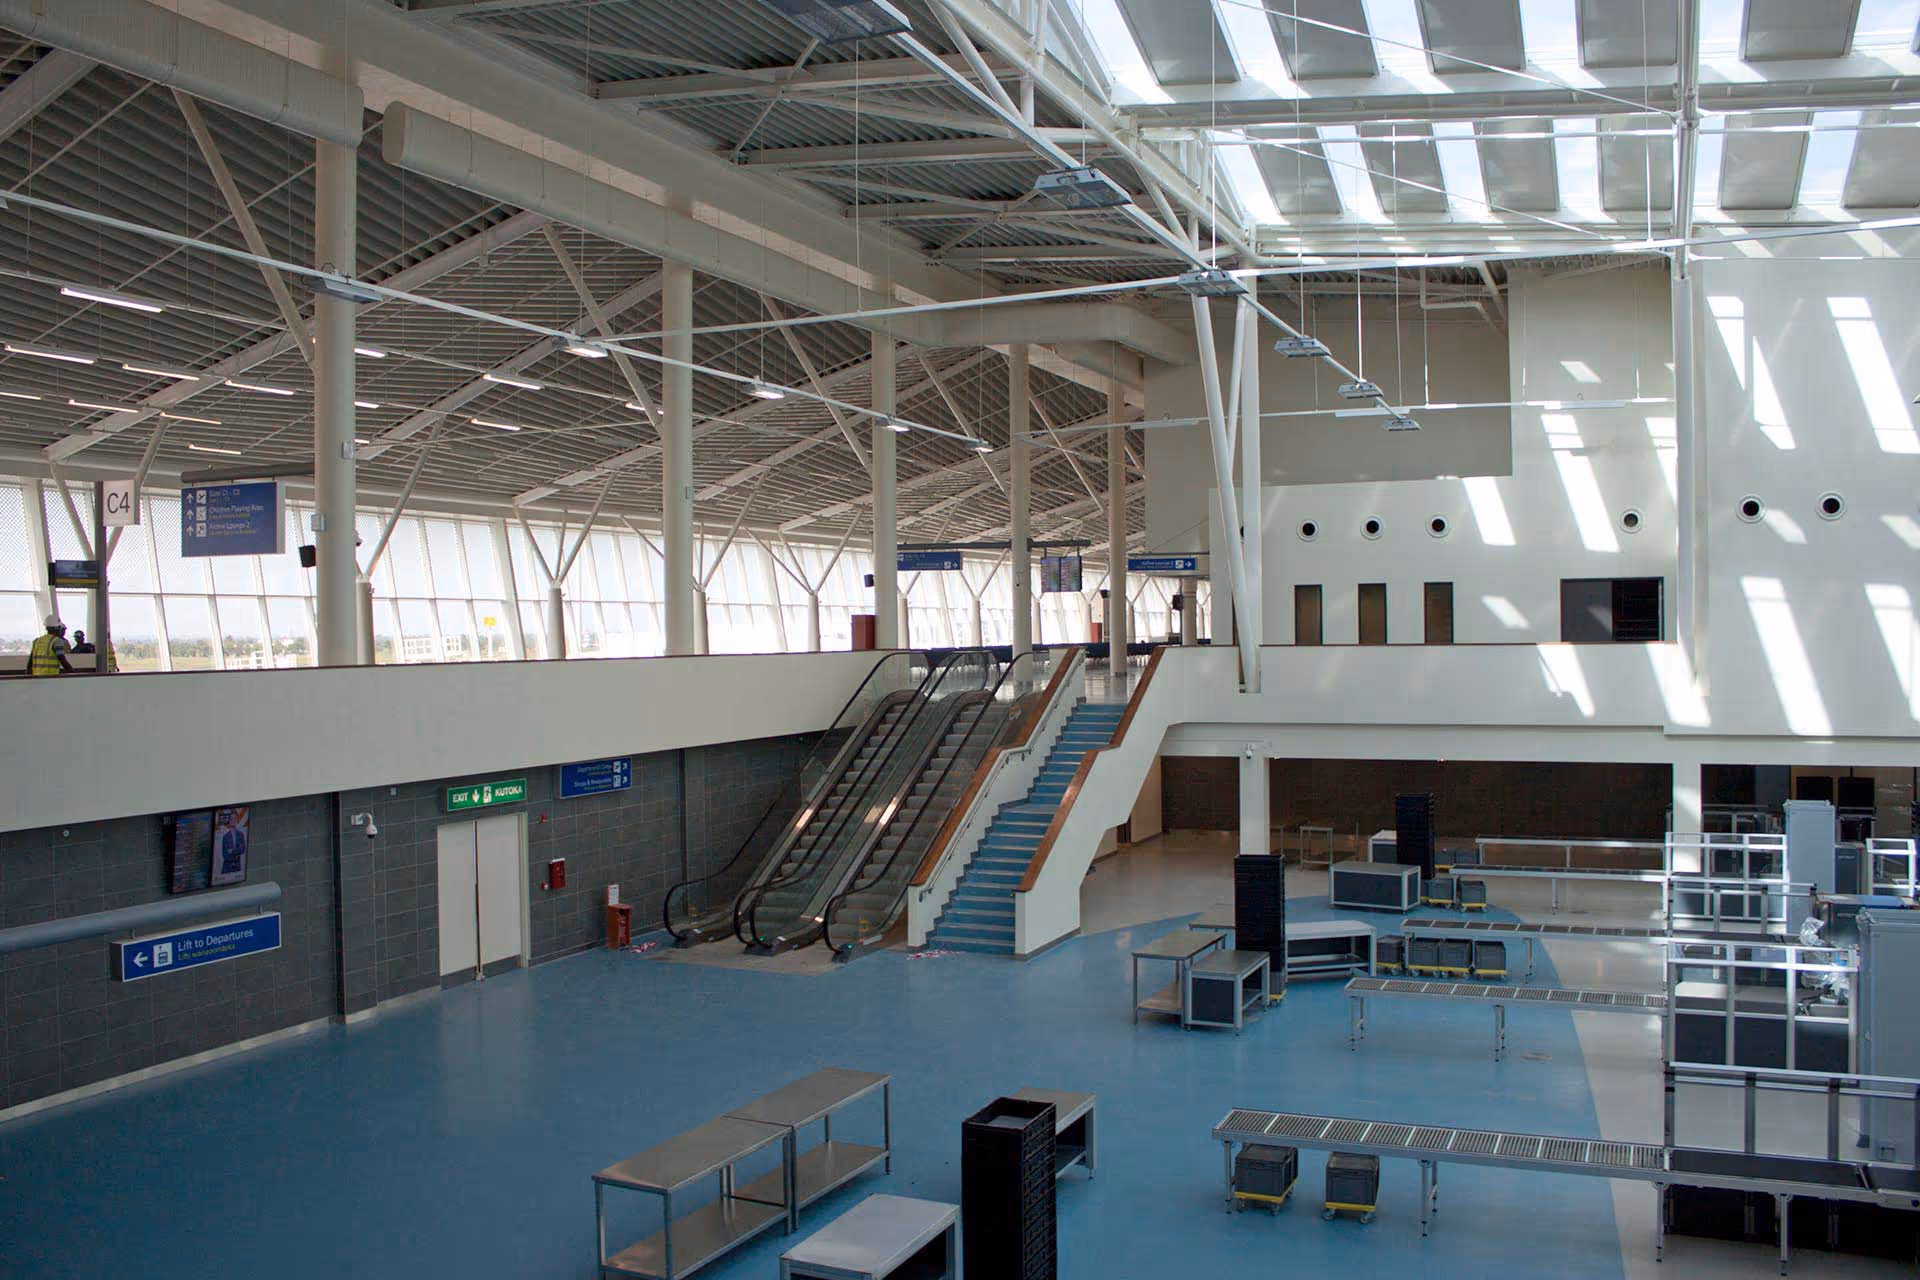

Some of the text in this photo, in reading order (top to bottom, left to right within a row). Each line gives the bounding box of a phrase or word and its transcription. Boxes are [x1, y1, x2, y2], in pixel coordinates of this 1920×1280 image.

[107, 492, 130, 514] C4
[452, 785, 523, 803] EXIT KUTOKA
[178, 929, 254, 952] Lift to Departures
